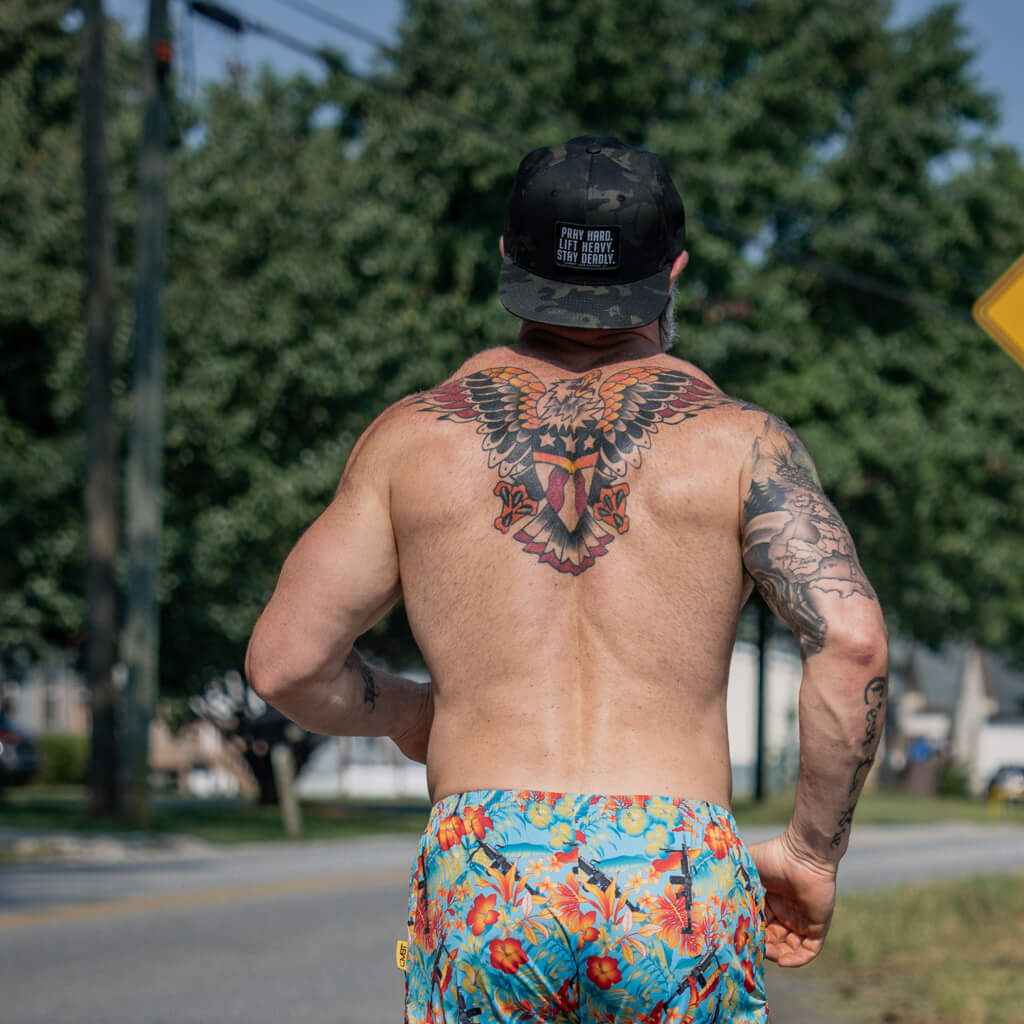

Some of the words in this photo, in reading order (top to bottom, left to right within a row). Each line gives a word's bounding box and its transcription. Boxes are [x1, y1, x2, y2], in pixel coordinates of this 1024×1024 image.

[561, 226, 584, 241] PRAY
[587, 230, 613, 242] HARD.
[559, 238, 578, 251] LIFT
[582, 241, 615, 253] HEAVY.
[557, 249, 578, 264] STAY
[581, 253, 616, 265] DEADLY.
